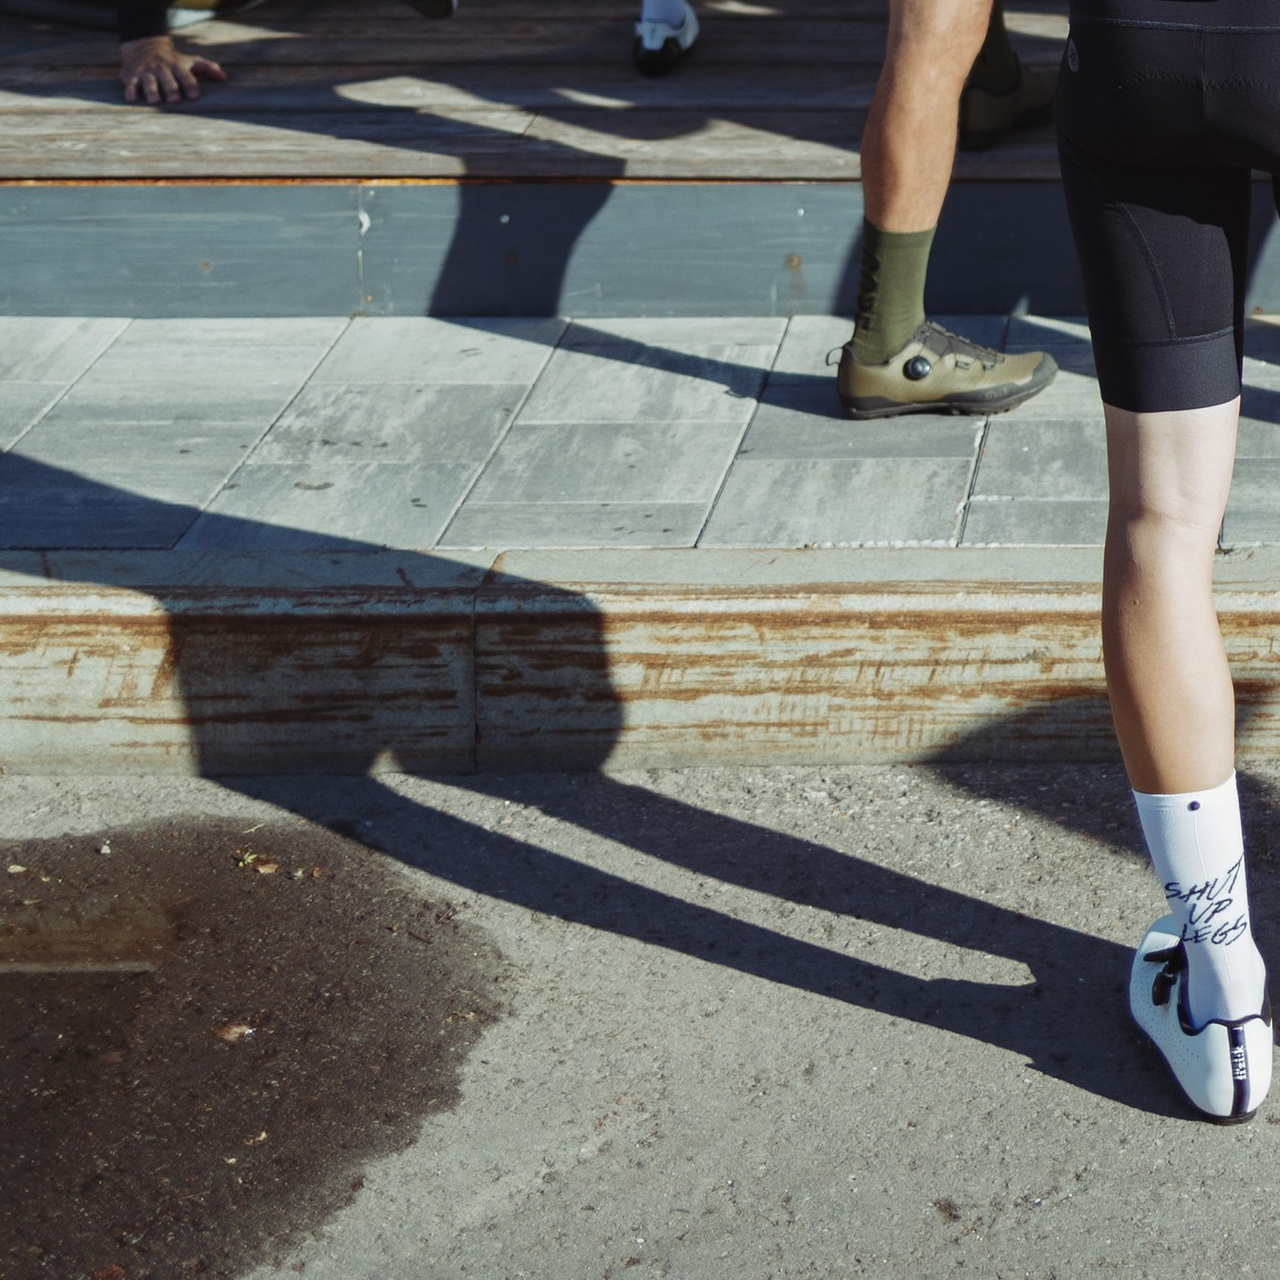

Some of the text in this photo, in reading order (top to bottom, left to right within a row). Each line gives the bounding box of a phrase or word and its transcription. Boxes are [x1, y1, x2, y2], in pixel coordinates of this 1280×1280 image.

[1164, 851, 1245, 903] SHUT
[1188, 898, 1234, 925] UP
[1181, 913, 1248, 946] LEGS
